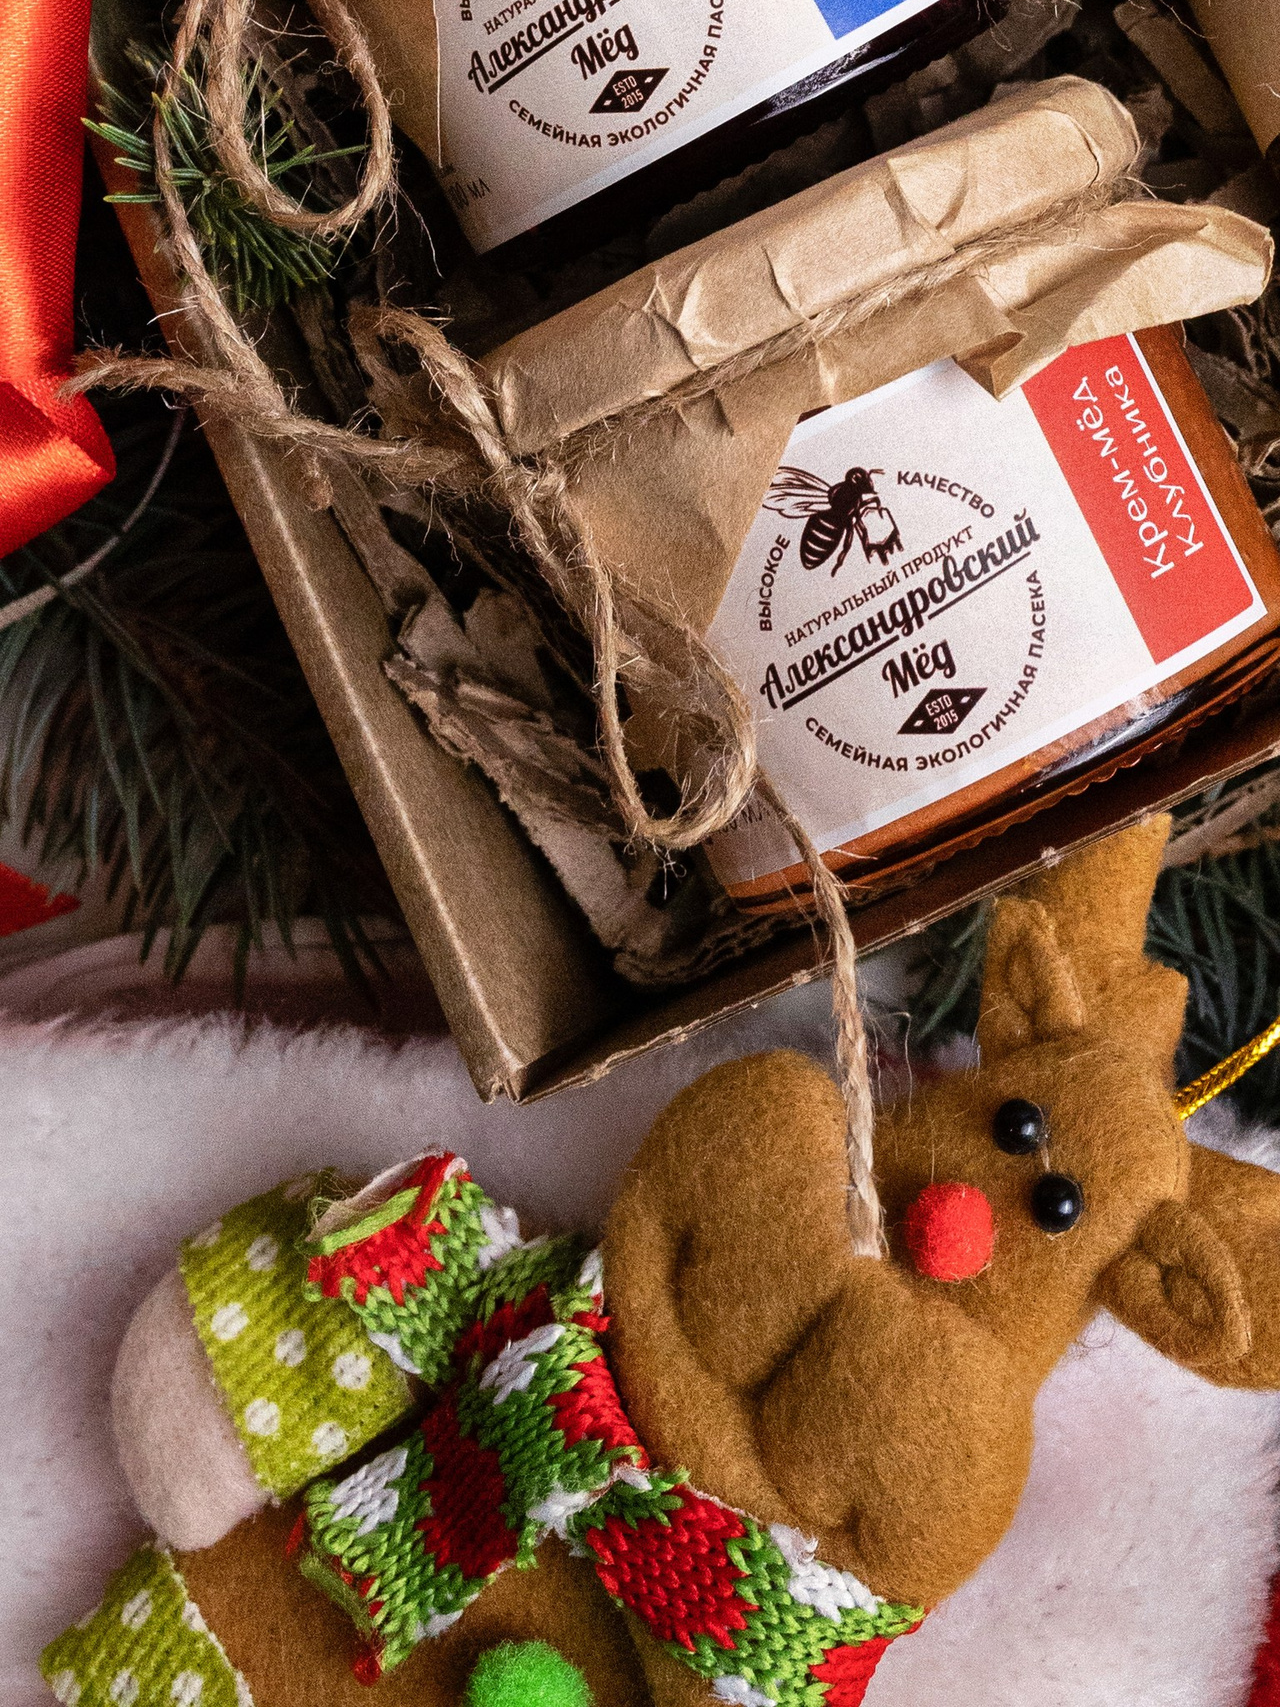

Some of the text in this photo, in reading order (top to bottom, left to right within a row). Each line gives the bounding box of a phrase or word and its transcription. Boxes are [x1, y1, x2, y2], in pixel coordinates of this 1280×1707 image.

[509, 100, 602, 148] СЕМЕЙНАЯ
[608, 46, 719, 147] ЭКОЛОГИЧНАЯ
[571, 23, 639, 81] Мёд
[612, 75, 636, 94] ESTD
[622, 90, 645, 110] 2015
[1072, 376, 1175, 579] Крем-мёд
[1105, 365, 1204, 556] Клубника
[760, 470, 994, 631] ВЫСОКОЕ КАЧЕСТВО
[785, 526, 974, 647] НАТУРАЛЬНЫЙ ПРОДУКТ
[760, 509, 1040, 710] Александровский
[806, 571, 1046, 771] СЕМЕЙНАЯ ЭКОЛОГИЧНАЯ ПАСЕКА
[882, 639, 956, 698] Мёд
[926, 695, 953, 715] ESTD
[934, 708, 959, 730] 2015
